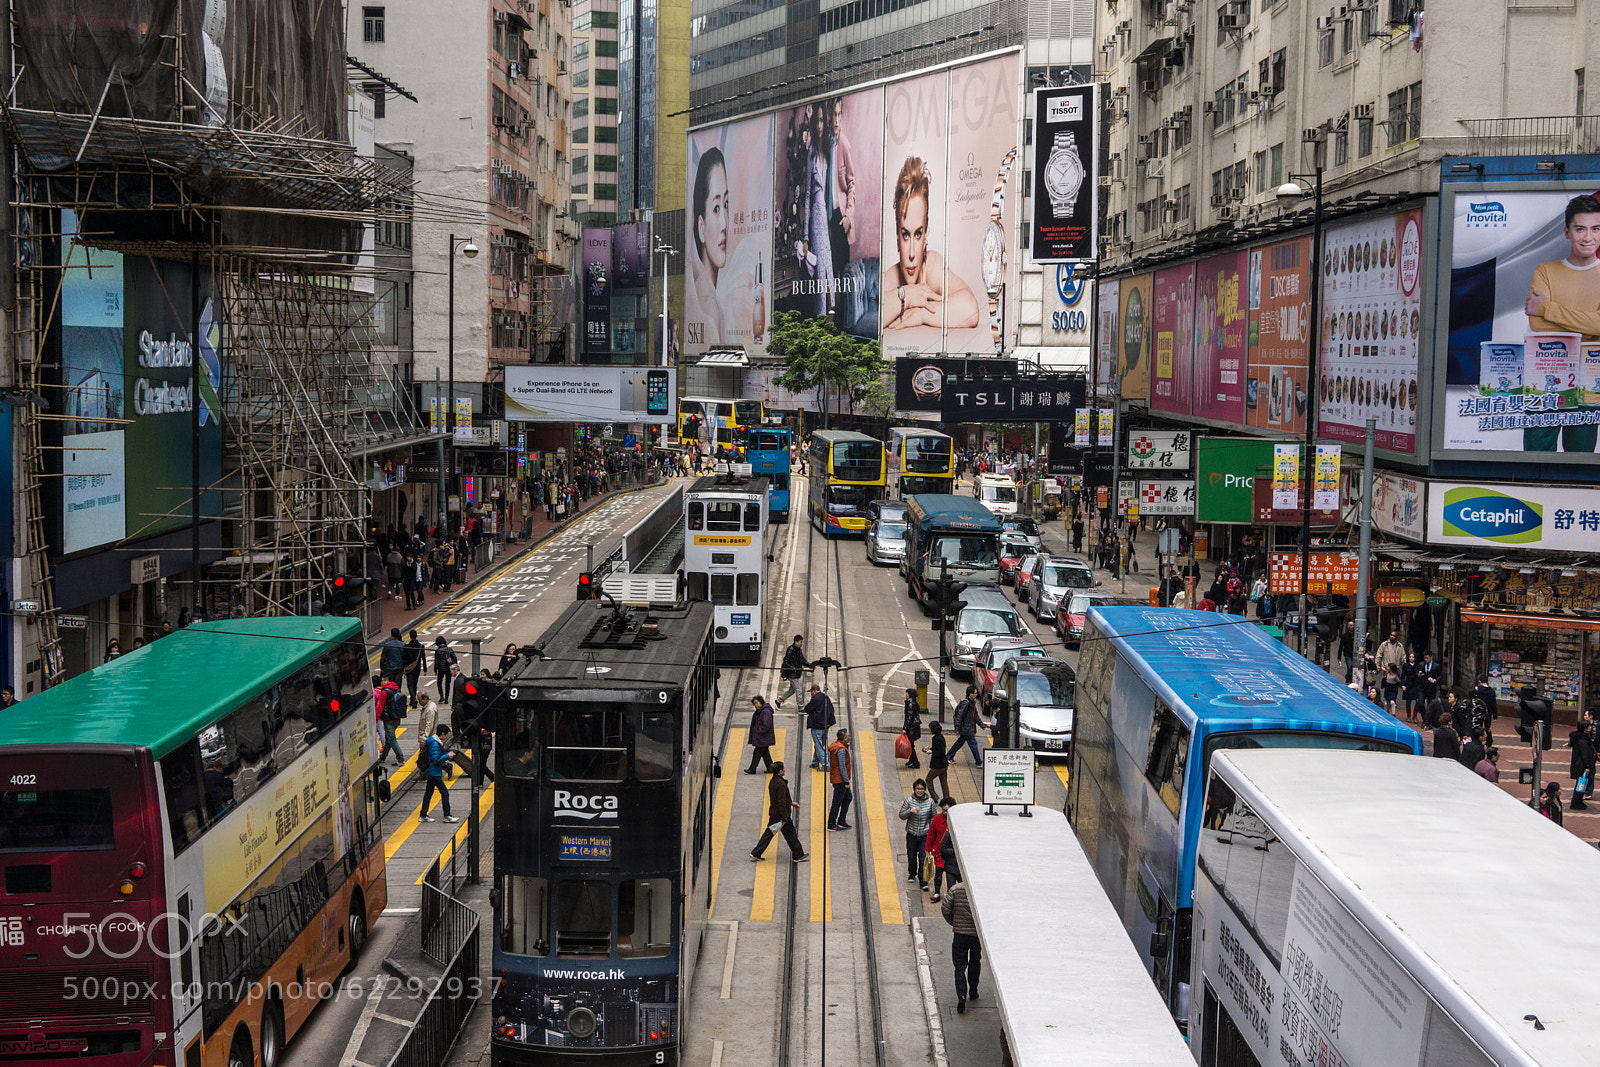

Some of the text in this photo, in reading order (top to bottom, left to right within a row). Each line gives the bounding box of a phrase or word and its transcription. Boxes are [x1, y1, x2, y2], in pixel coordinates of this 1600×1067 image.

[887, 64, 1015, 145] OMEGA
[1051, 107, 1078, 115] TISSOT
[959, 167, 982, 180] OMEGA
[1466, 213, 1507, 222] Inovital
[792, 277, 861, 296] BURBERRY
[1052, 311, 1085, 331] SOGO
[139, 330, 192, 368] Standard
[528, 380, 560, 388] Experience
[1517, 374, 1522, 385] 1
[1568, 373, 1576, 387] 2
[134, 378, 192, 416] Chartered
[518, 387, 534, 395] Super
[956, 391, 1071, 406] TSL 謝瑞麟
[1460, 394, 1559, 415] 法國育嬰之寶
[1460, 507, 1524, 527] Cetaphil
[471, 592, 526, 602] 巴士
[458, 604, 504, 614] 站
[435, 617, 497, 626] BUS
[417, 626, 492, 636] STOP
[510, 688, 518, 699] 9
[659, 691, 667, 703] 9
[10, 775, 36, 785] 4022
[554, 790, 618, 809] Roca
[562, 836, 611, 847] Western Market
[37, 921, 146, 936] CHOW TAI FOOK
[544, 969, 625, 979] www.roca.hk
[0, 1041, 61, 1053] NVIRO
[655, 1051, 665, 1065] 9
